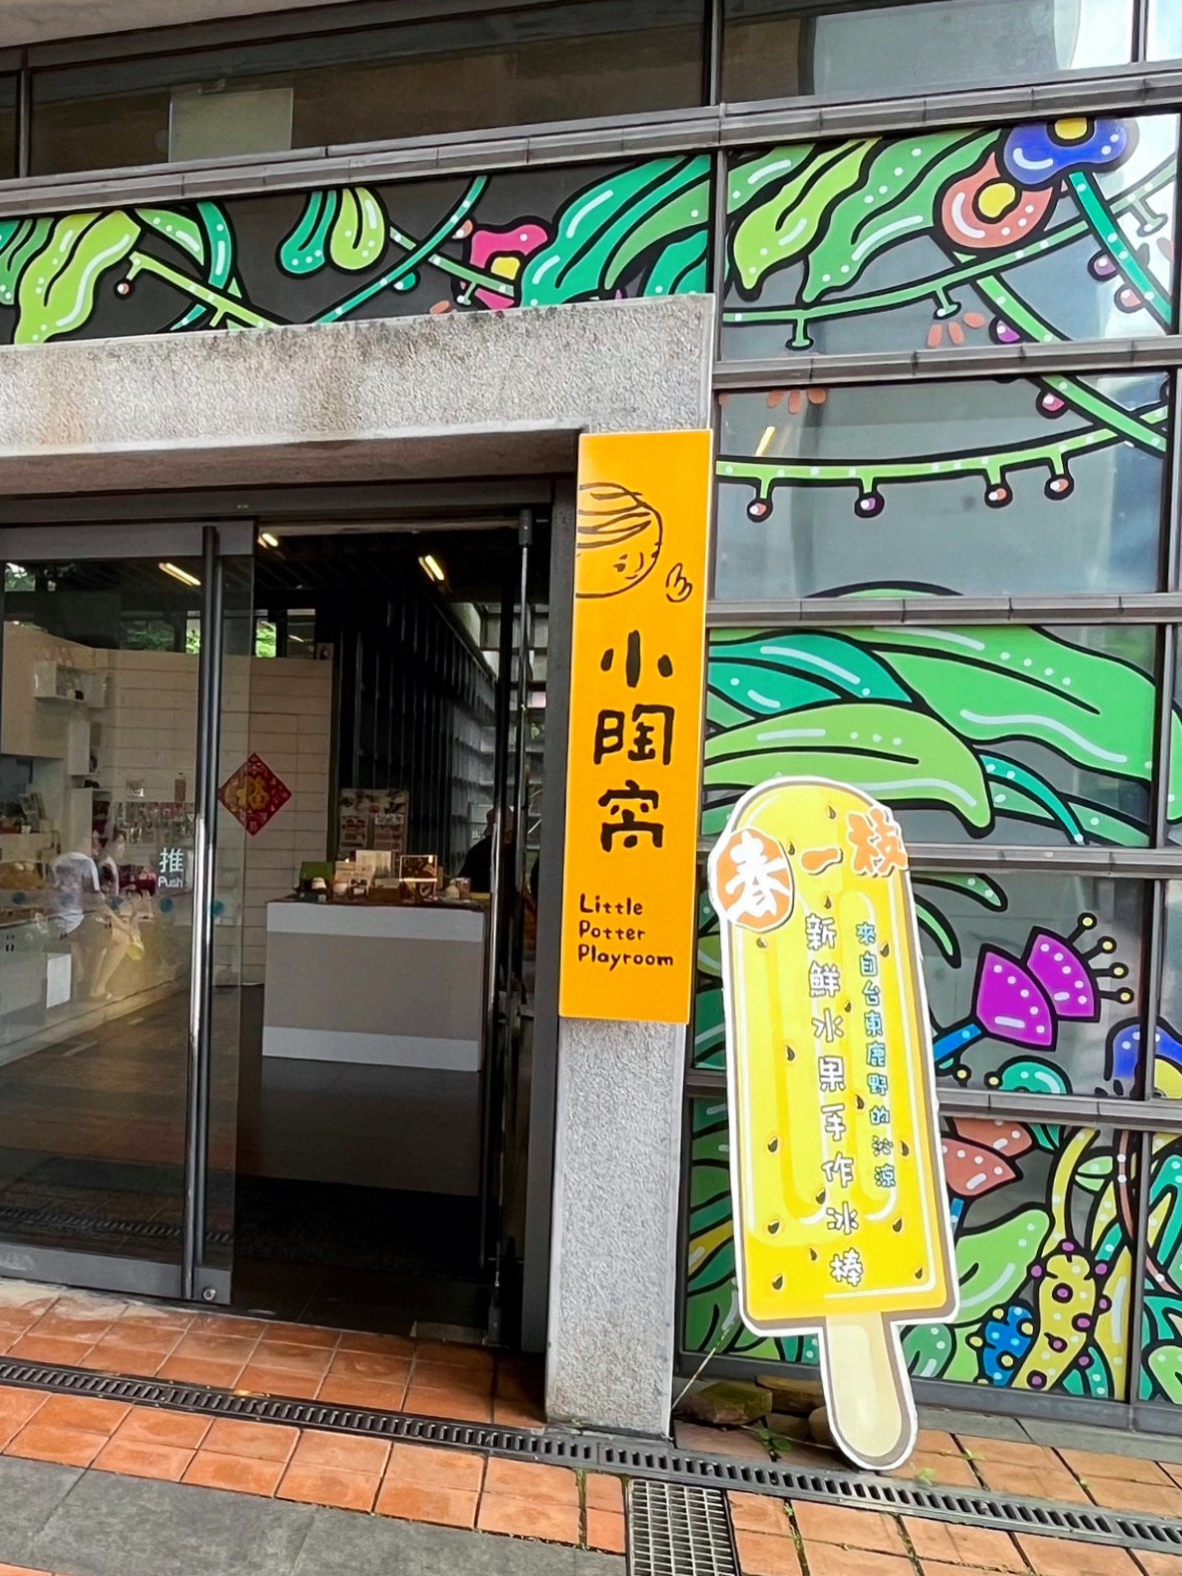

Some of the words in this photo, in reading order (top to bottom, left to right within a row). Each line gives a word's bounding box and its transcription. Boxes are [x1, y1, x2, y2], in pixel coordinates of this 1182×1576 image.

[158, 847, 184, 873] 推
[158, 876, 183, 888] Push
[580, 893, 643, 915] Little
[579, 919, 646, 941] Potter
[578, 944, 673, 971] Playroom
[805, 913, 863, 1288] 新鮮水果手作冰棒
